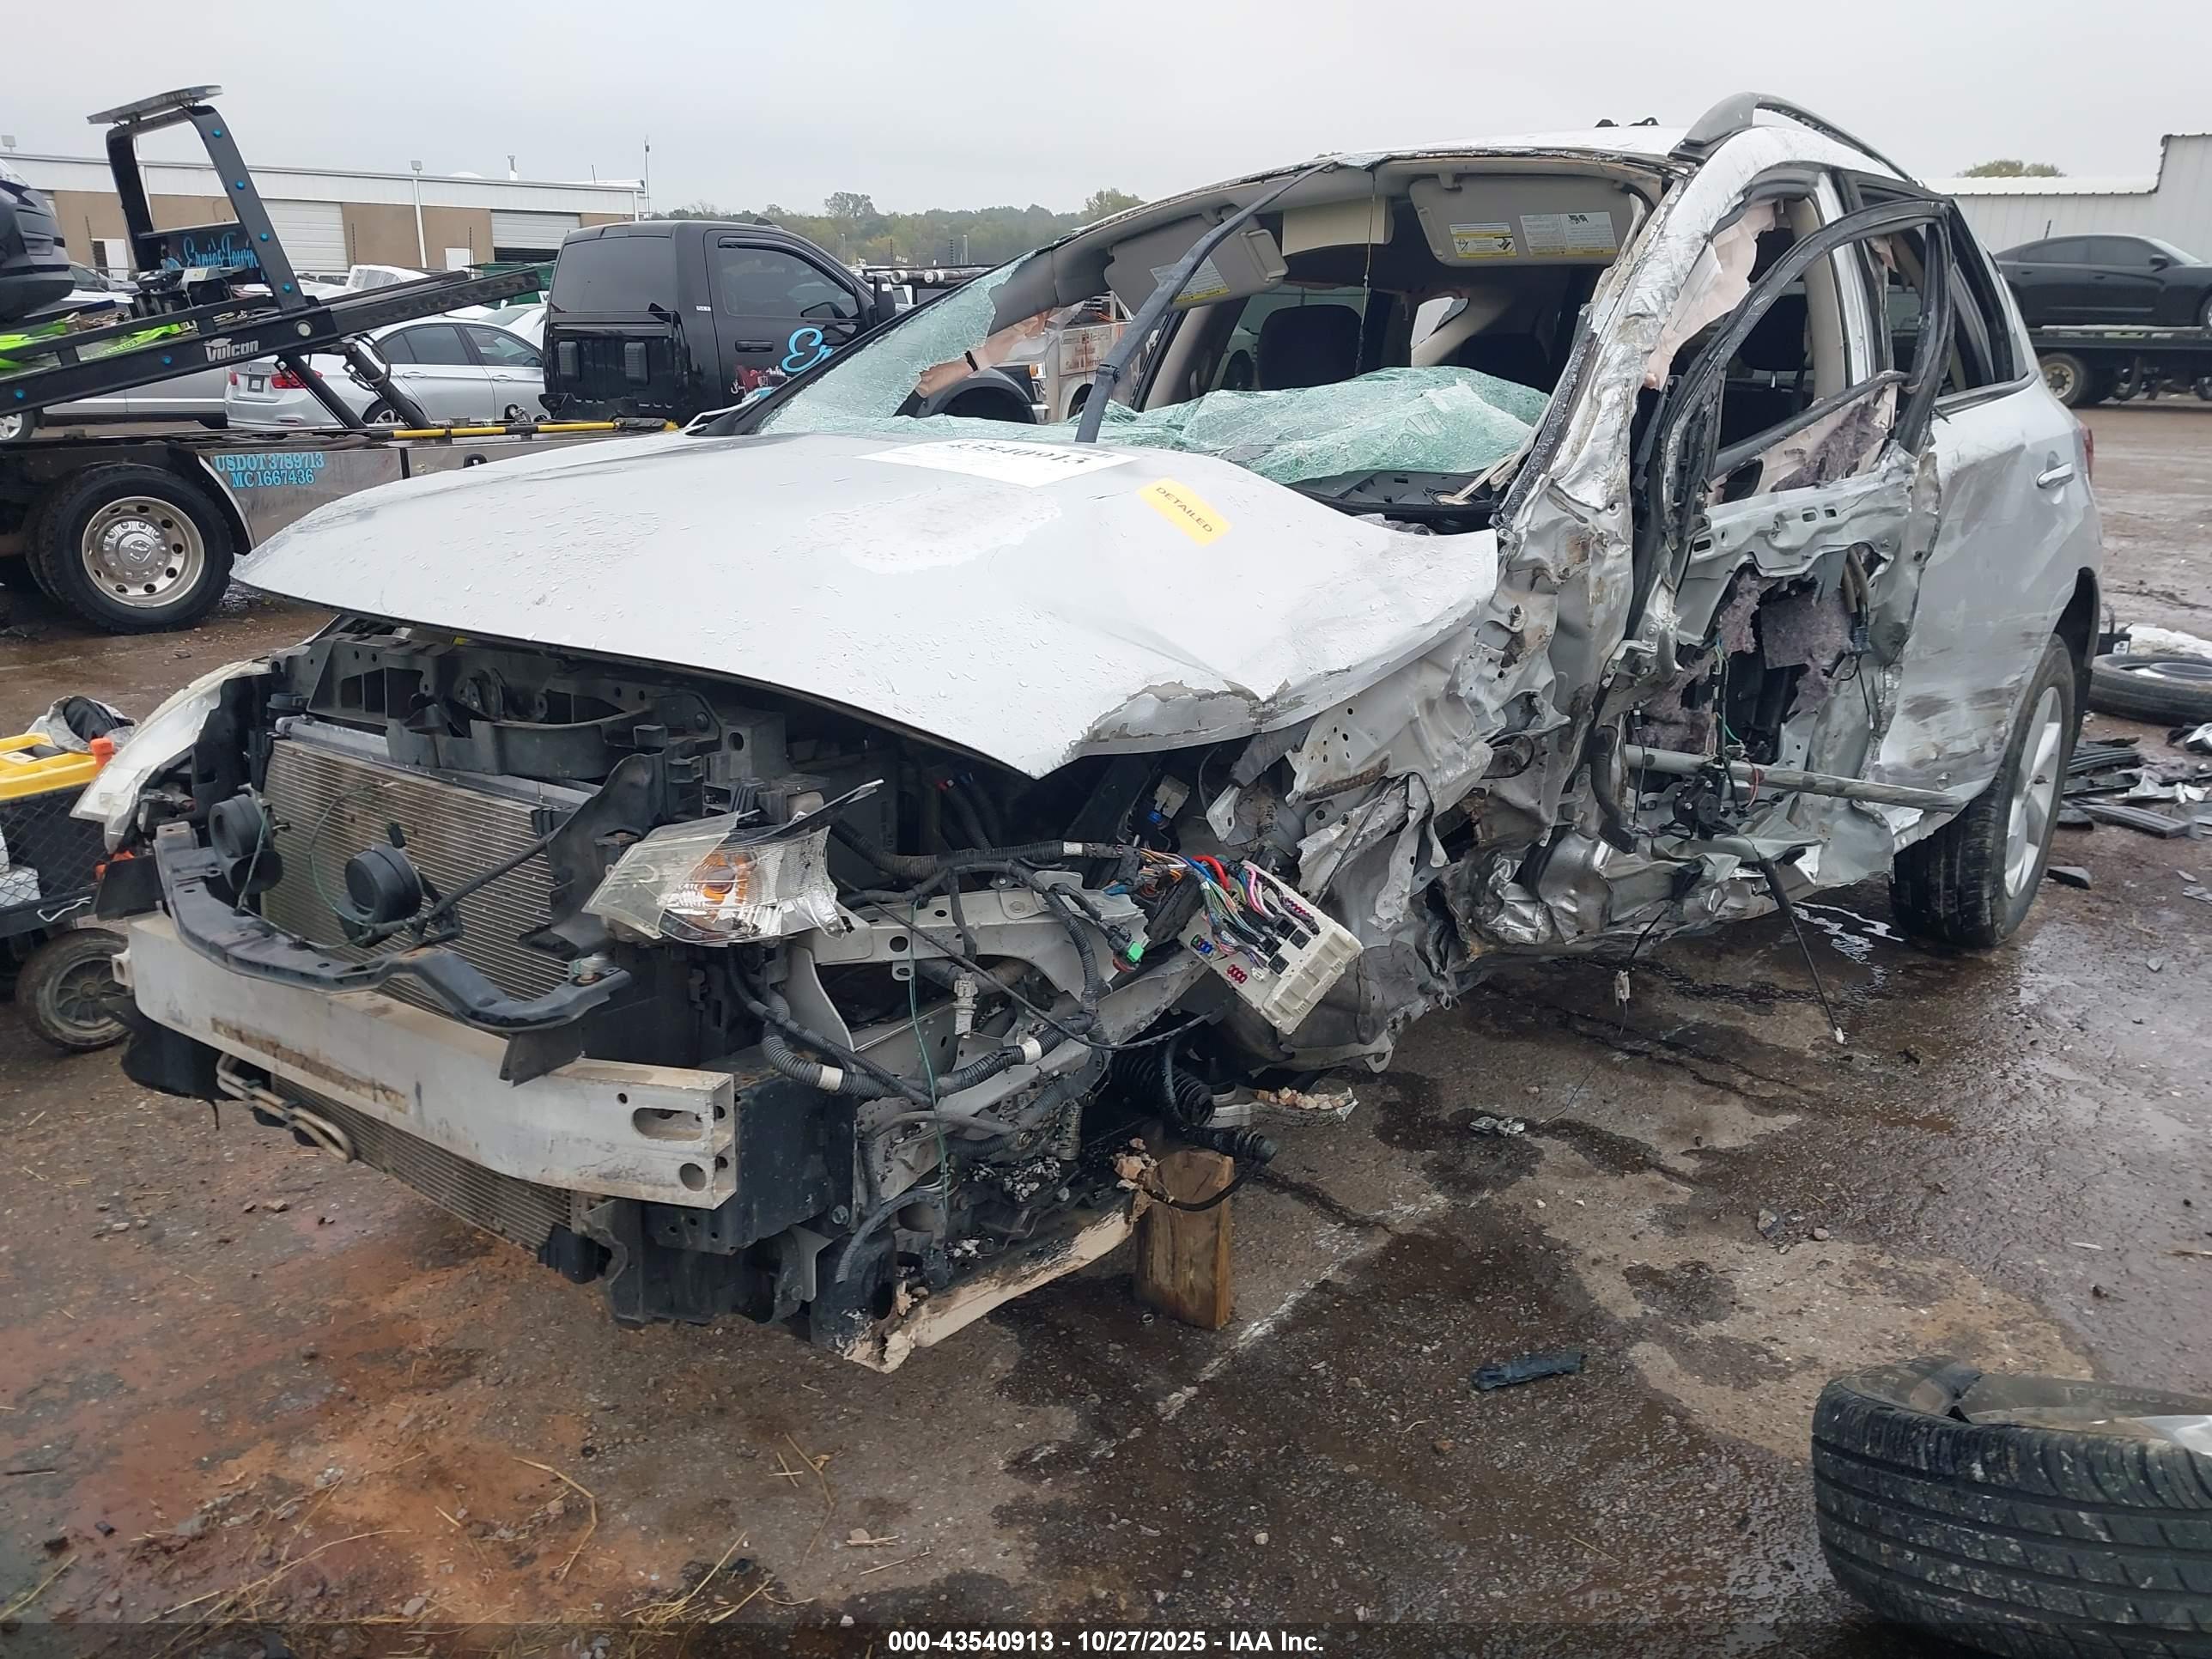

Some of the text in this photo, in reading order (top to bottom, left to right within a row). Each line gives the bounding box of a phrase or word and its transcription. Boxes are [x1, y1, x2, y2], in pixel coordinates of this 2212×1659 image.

[183, 232, 262, 273] Ernie's Towin
[205, 340, 259, 362] Vulcan
[214, 453, 325, 471] USDOT 3789713
[947, 443, 1091, 465] 43540913
[230, 468, 315, 488] MC 1667436
[1156, 487, 1213, 532] DETAILED
[2062, 1386, 2162, 1404] TOURING
